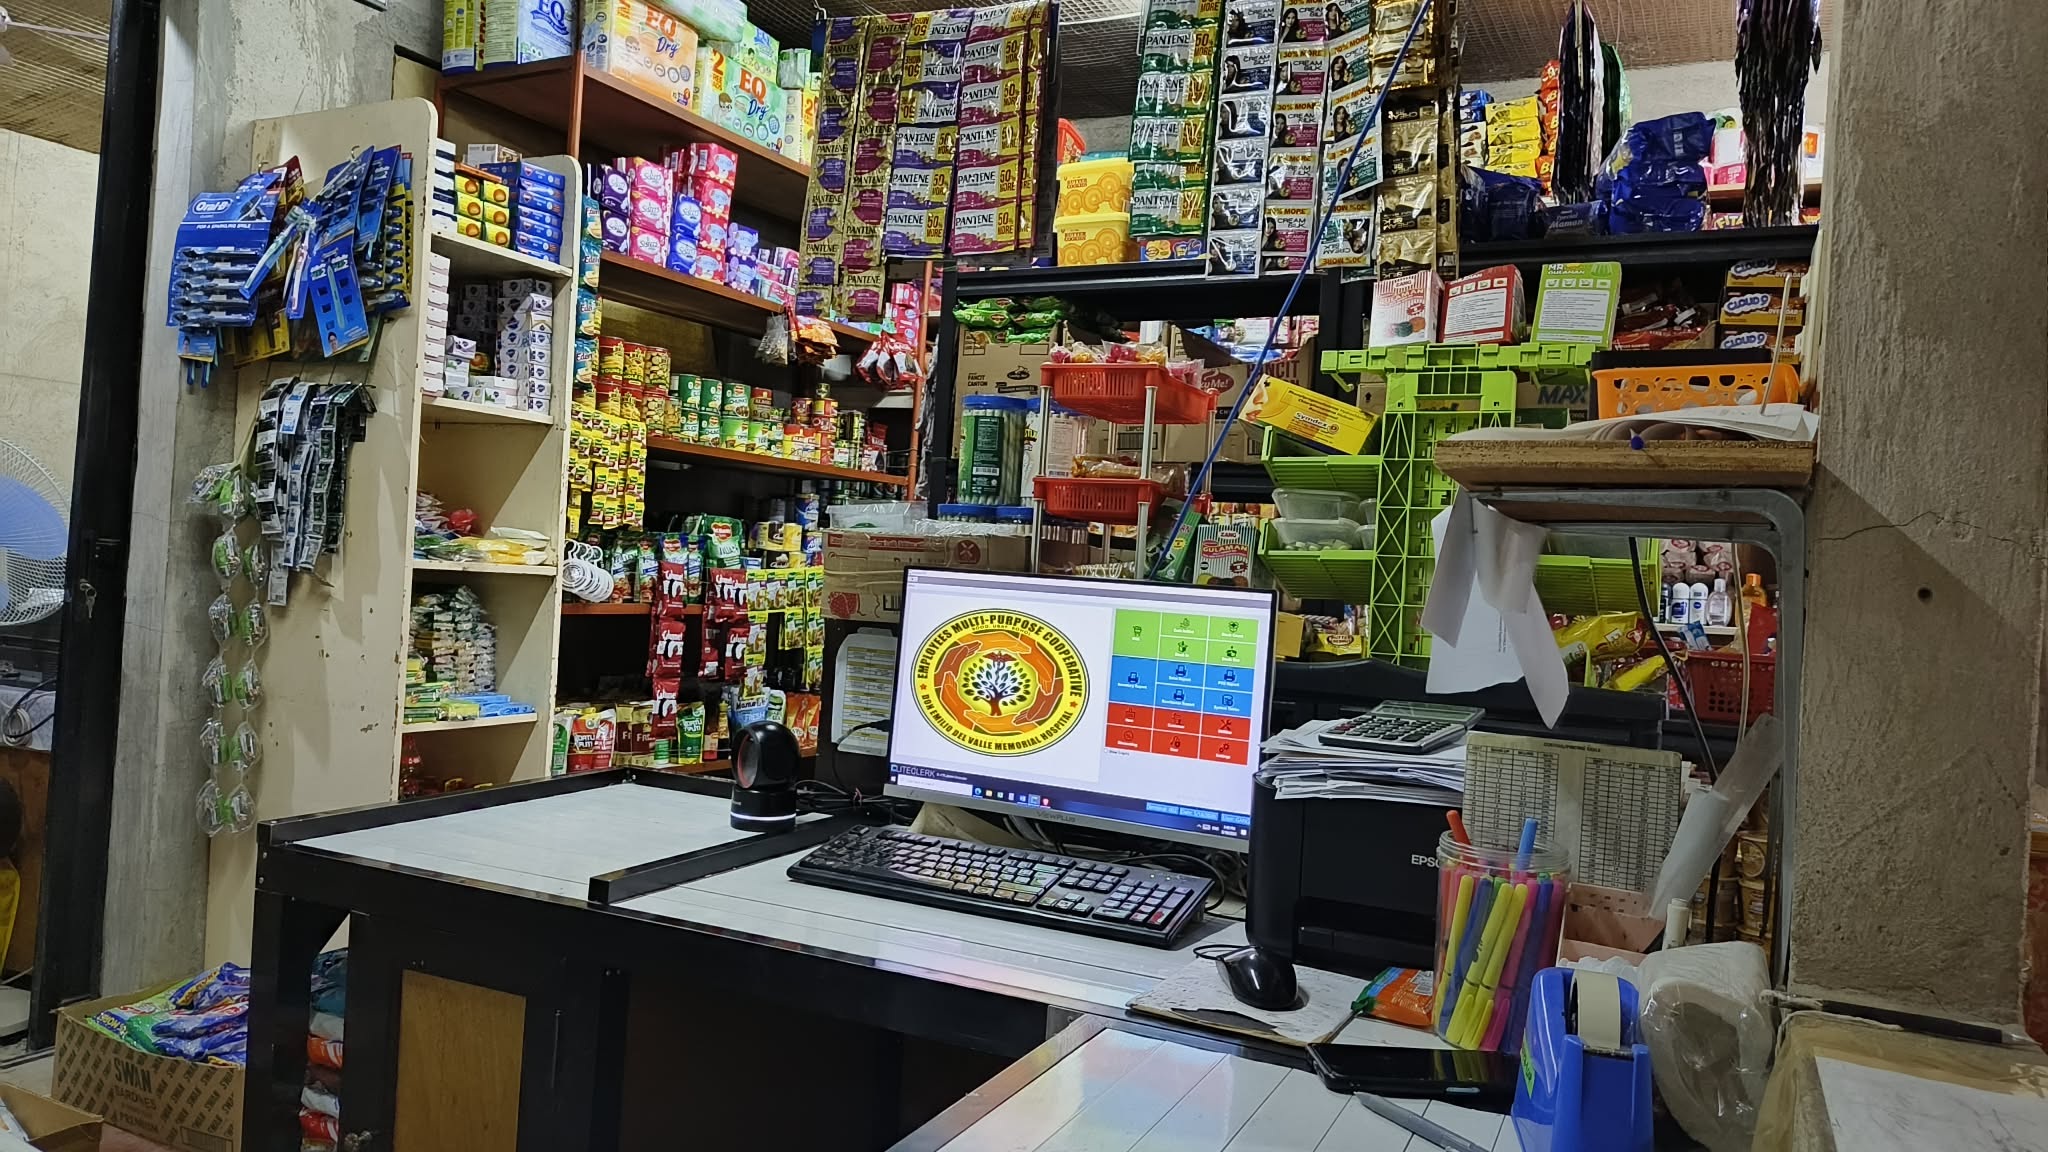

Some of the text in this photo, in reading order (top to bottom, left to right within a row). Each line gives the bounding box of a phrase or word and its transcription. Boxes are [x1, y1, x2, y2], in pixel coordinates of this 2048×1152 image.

[1200, 2, 1218, 12] MORE
[646, 6, 677, 42] EQ
[875, 24, 908, 33] PANTENE
[931, 24, 968, 35] PANTENE
[1147, 34, 1190, 46] PANTENE
[656, 36, 679, 58] Dry
[1195, 47, 1213, 57] MORE
[740, 68, 767, 105] EQ
[748, 99, 767, 120] Dry
[897, 132, 935, 143] PANTENE
[817, 144, 848, 154] PANTENE
[892, 173, 930, 184] PANTENE
[958, 171, 996, 184] PANTENE
[1000, 181, 1016, 191] MORE
[812, 195, 843, 204] PANTENE
[195, 200, 230, 213] Oral-B
[887, 214, 924, 225] PANTENE
[955, 213, 994, 226] PANTENE
[926, 228, 943, 238] MORE
[998, 225, 1014, 235] MORE
[807, 244, 838, 254] PANTENE
[848, 275, 881, 285] PANTENE
[576, 353, 592, 362] Eden
[1211, 378, 1230, 389] Me!
[1538, 384, 1588, 404] MAX
[1203, 544, 1248, 553] GULAMAN
[917, 614, 1082, 697] EMPLOYEES MULTI-PURPOSE COOPERATIVE
[921, 694, 1074, 750] DON EMILIO DEL VALLE MEMORIAL HOSPITAL
[113, 1058, 152, 1093] SWAN
